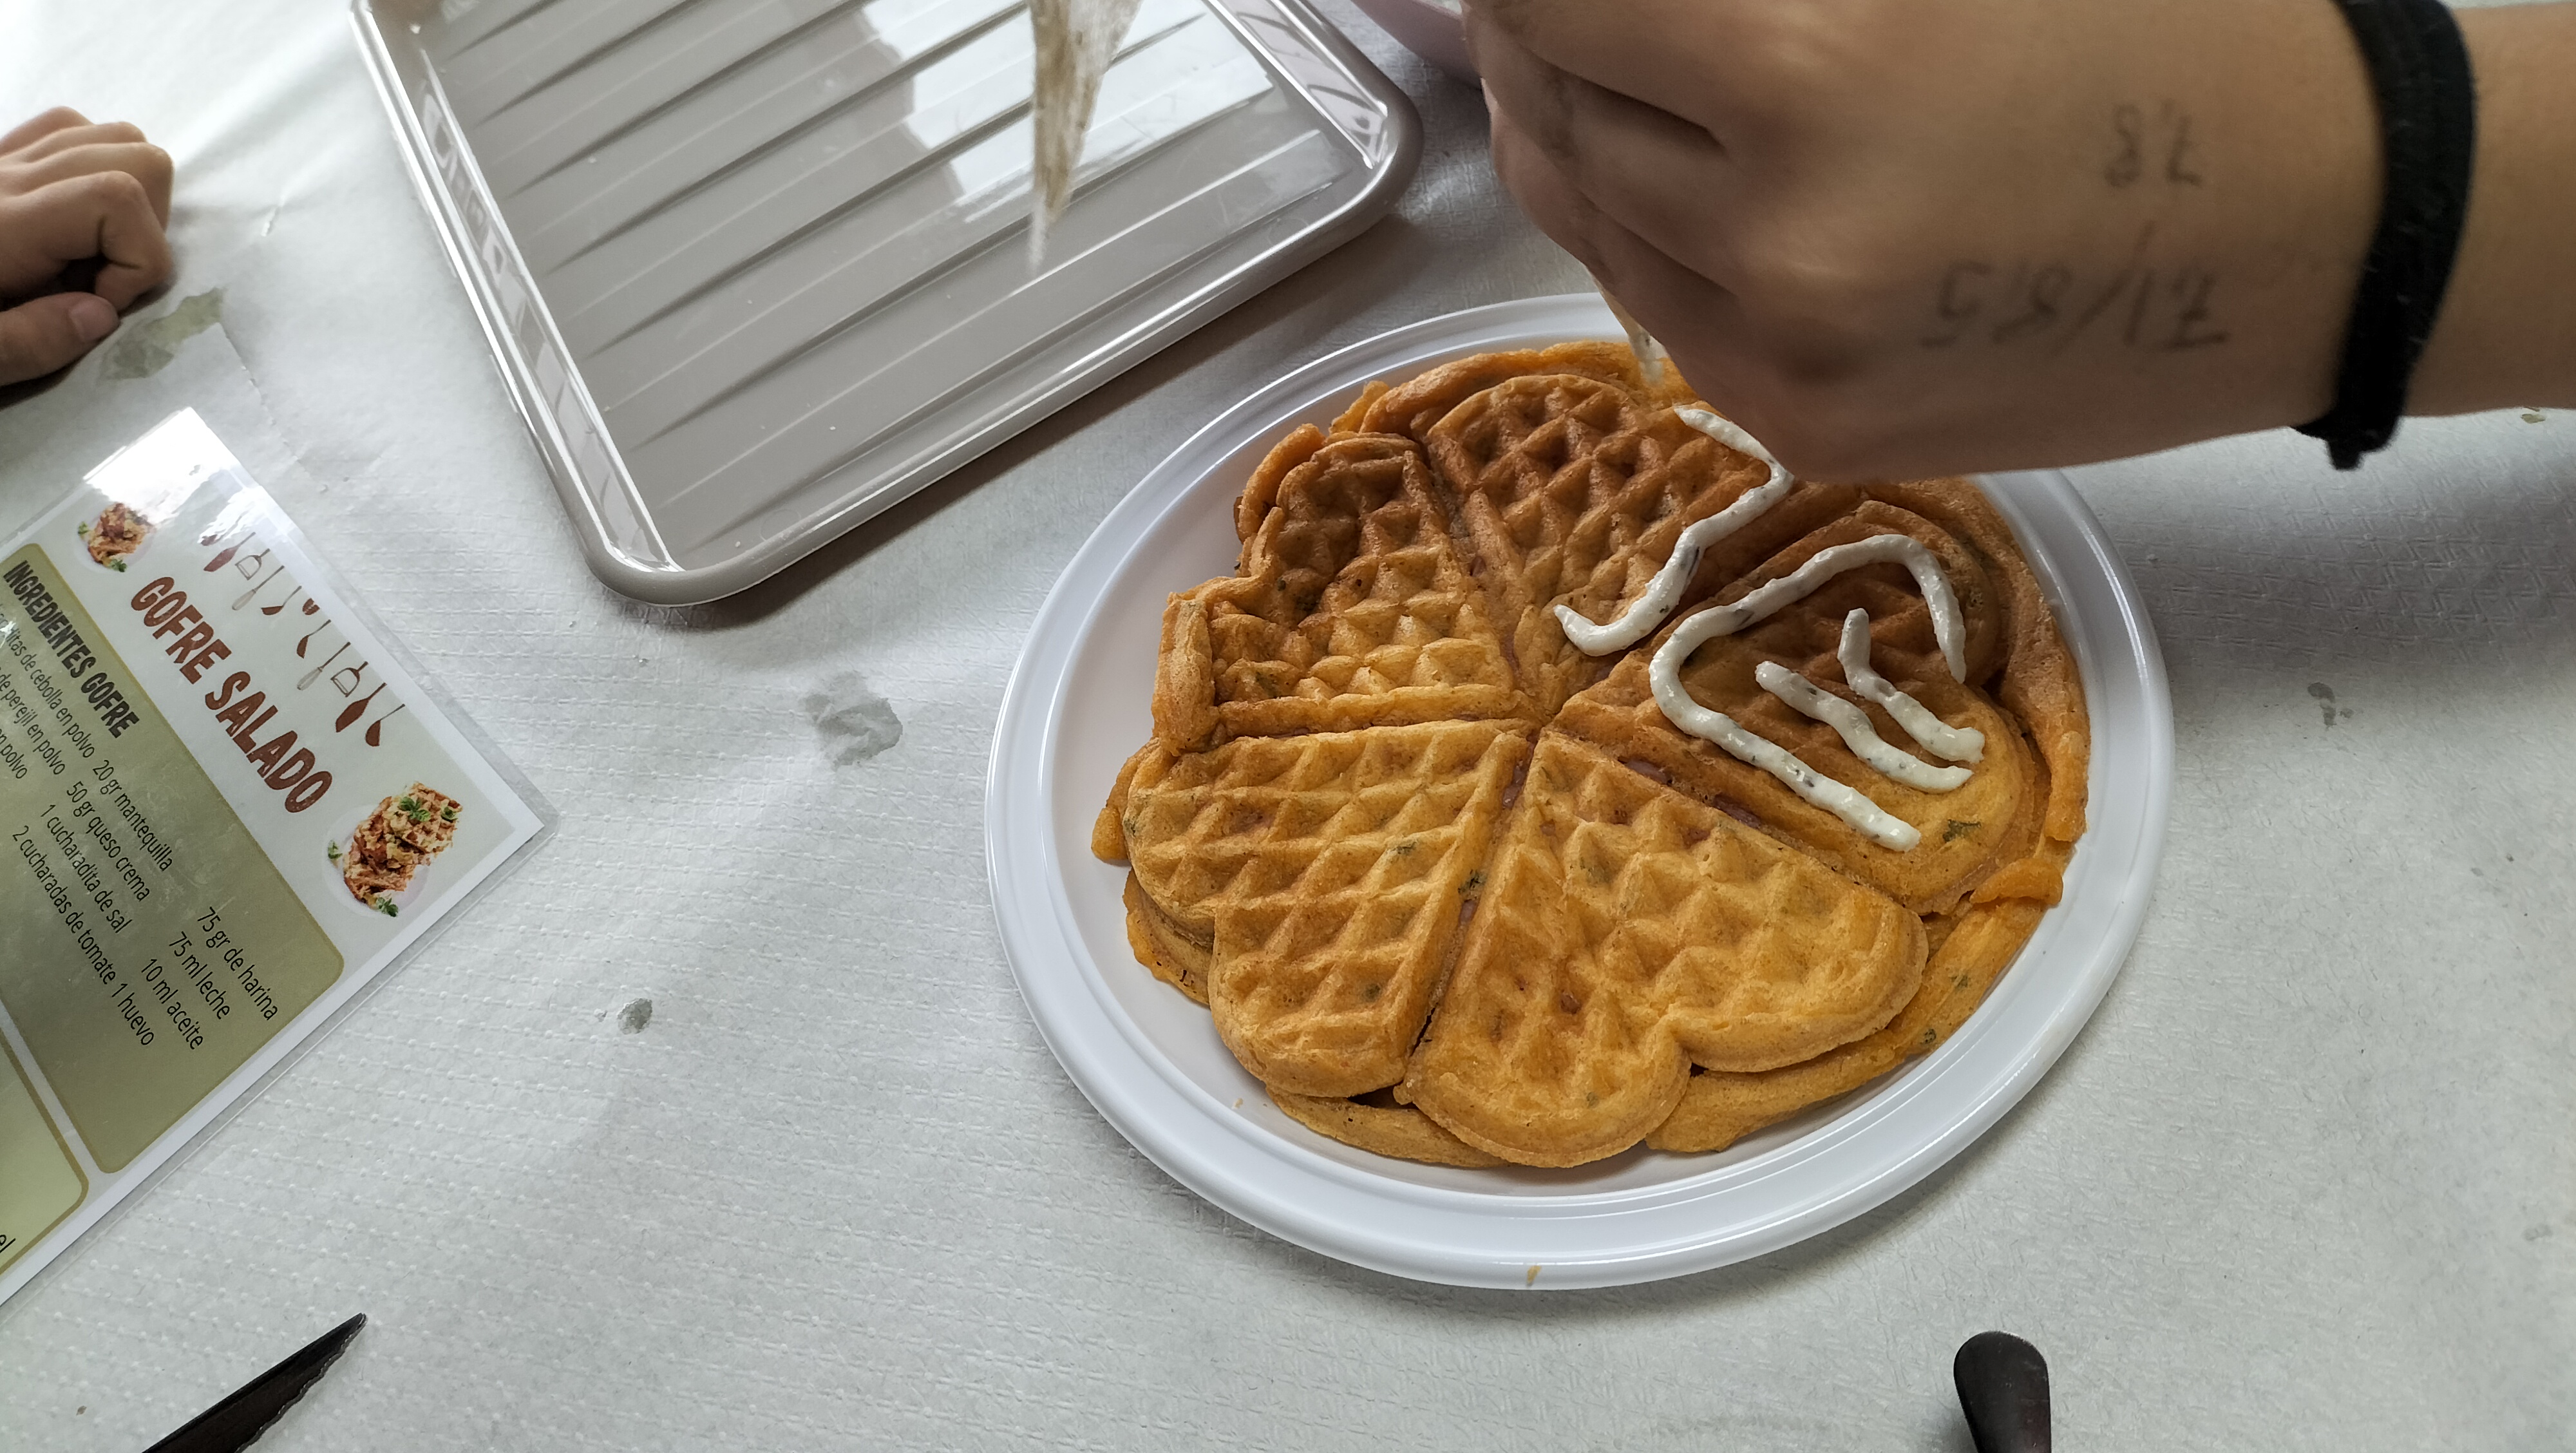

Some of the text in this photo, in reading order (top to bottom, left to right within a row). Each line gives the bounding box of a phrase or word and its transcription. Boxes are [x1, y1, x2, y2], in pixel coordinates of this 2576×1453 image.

[3, 560, 140, 739] INGREDIENTES GOFRE
[21, 654, 37, 671] de
[0, 689, 38, 727] perejil
[30, 669, 63, 710] cebolla
[56, 707, 73, 726] en
[131, 576, 332, 813] GOFRE SALADO
[0, 743, 28, 779] polvo
[27, 724, 44, 743] en
[33, 739, 66, 775] polvo
[64, 722, 95, 758] polvo
[67, 781, 150, 902] 50 gr queso crema
[93, 759, 173, 871] 20 gr mantequilla
[12, 825, 116, 985] 2 cucharadas de tomate
[41, 804, 133, 933] 1 cucharadita de sal
[169, 931, 231, 1020] 75 ml leche
[197, 906, 278, 1021] 75 gr de harina
[111, 983, 155, 1046] 1 huevo
[140, 958, 204, 1050] 10 ml aceite
